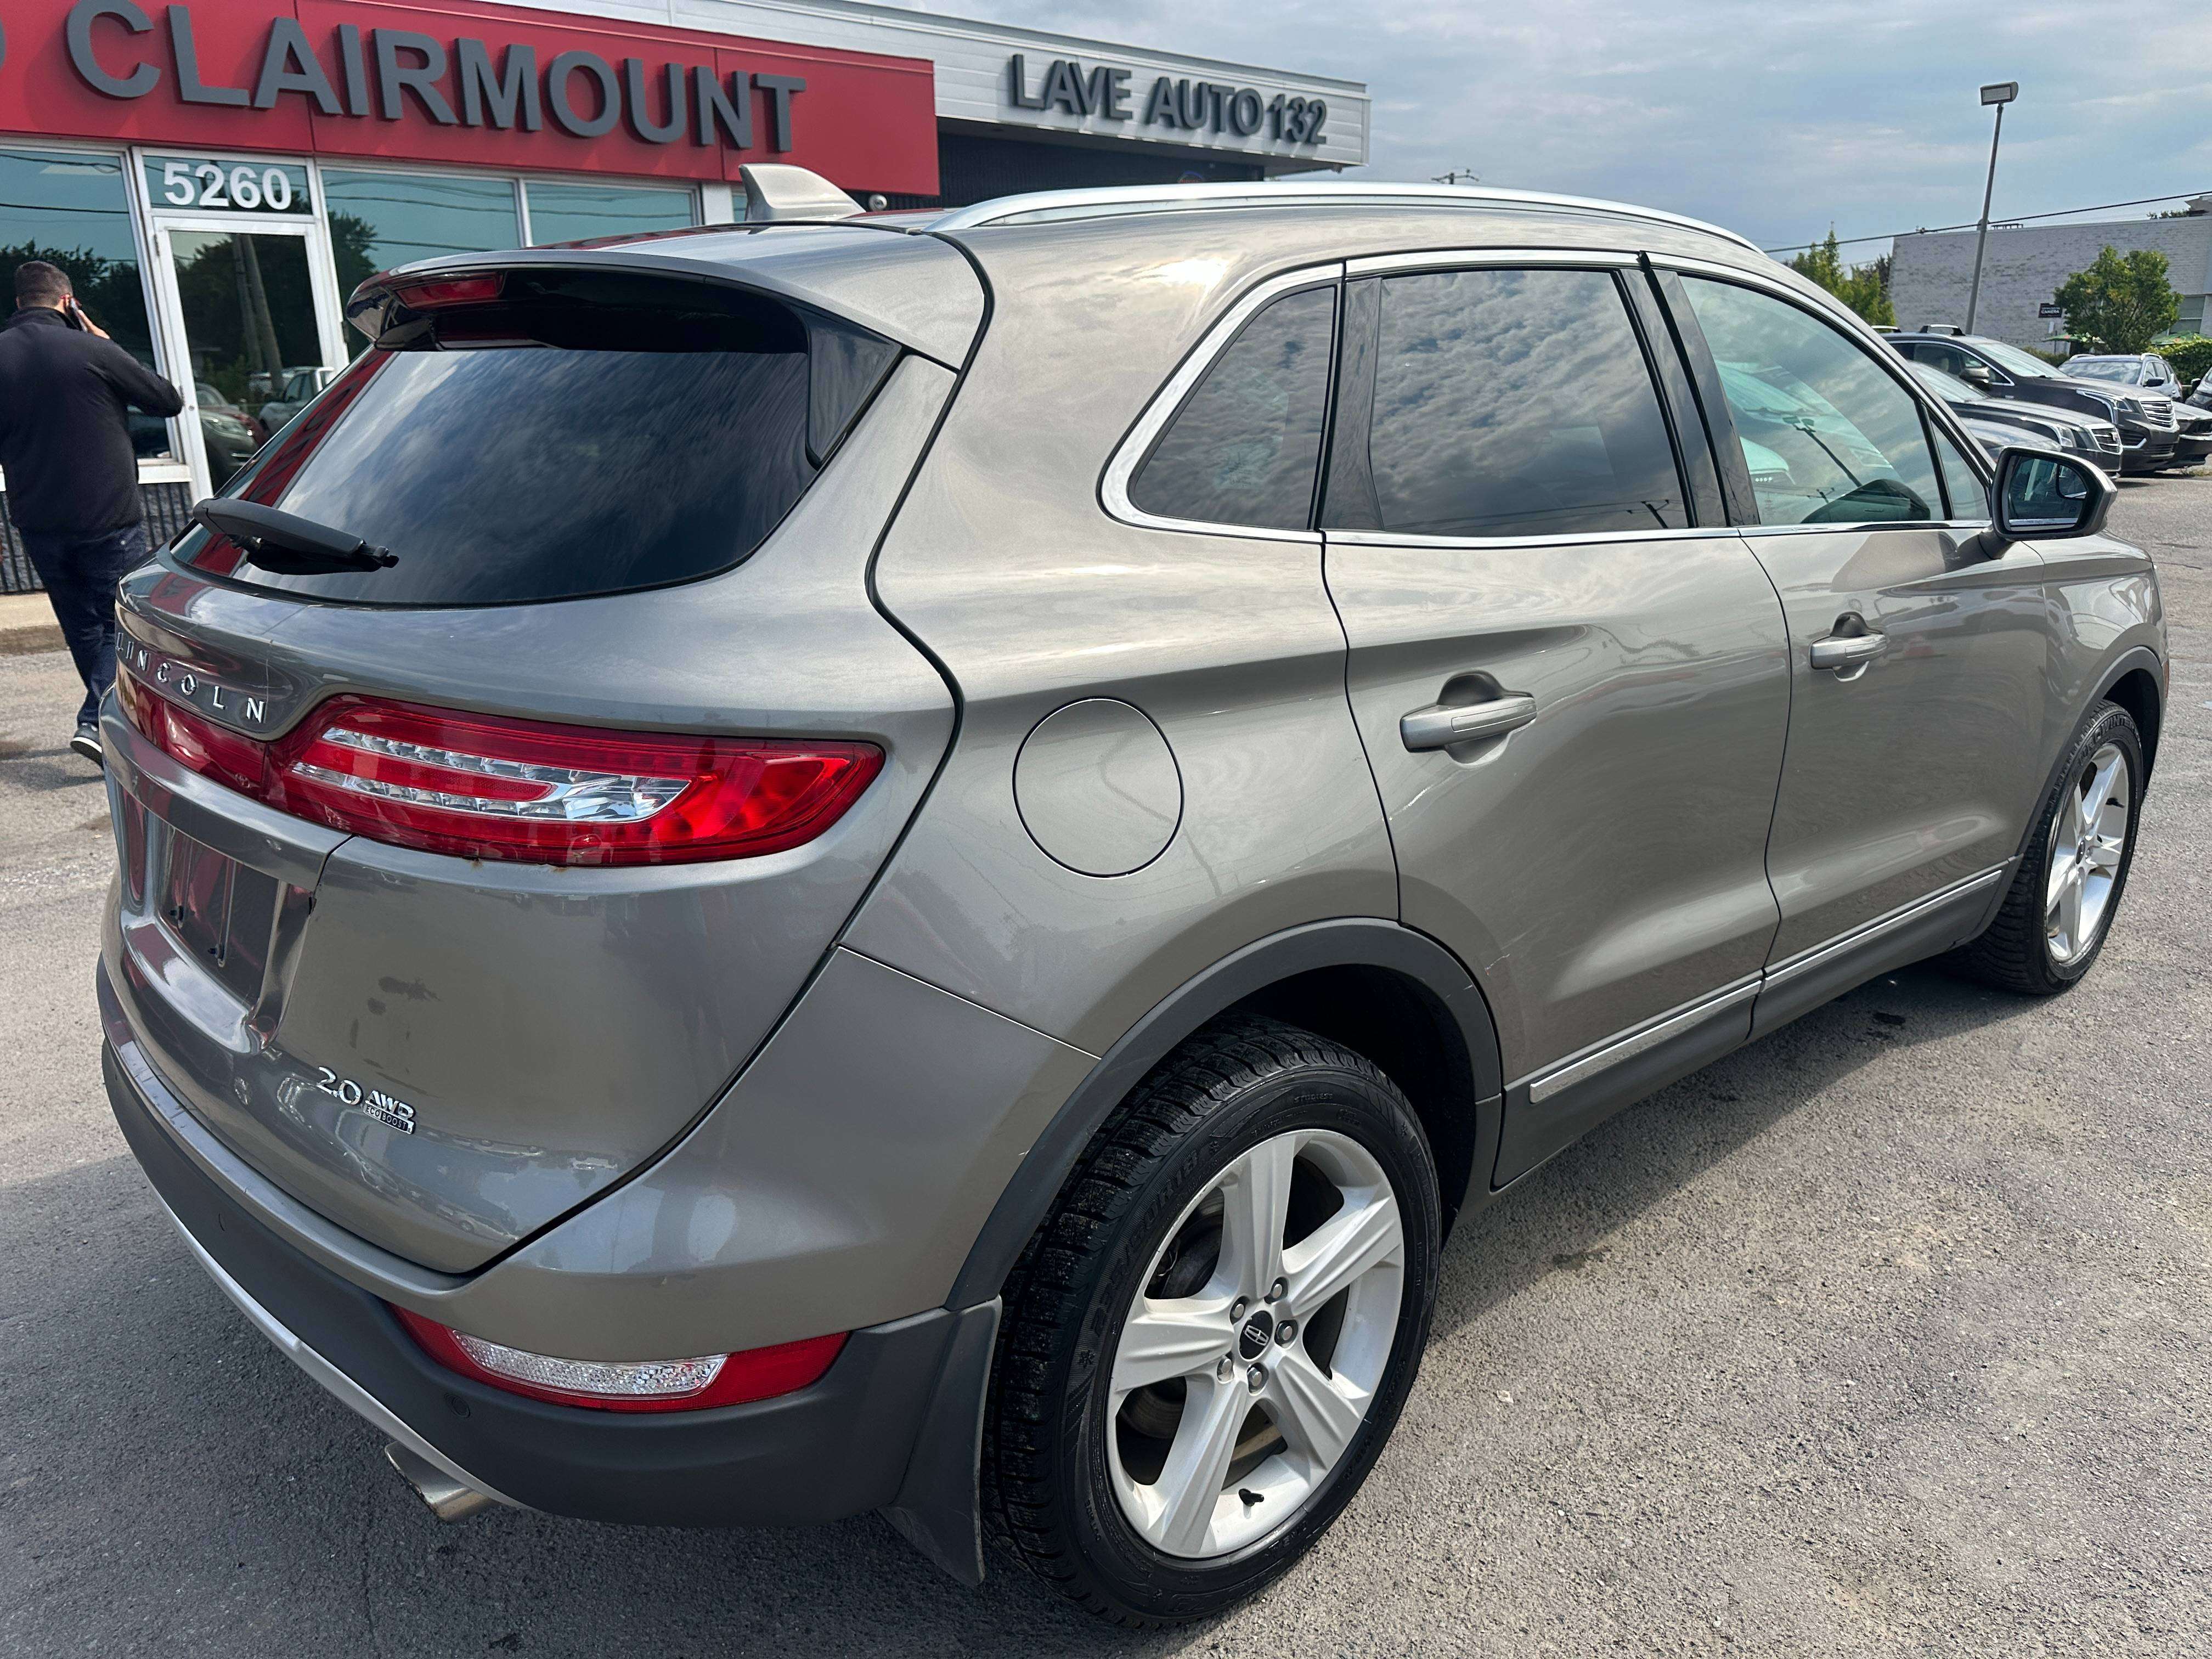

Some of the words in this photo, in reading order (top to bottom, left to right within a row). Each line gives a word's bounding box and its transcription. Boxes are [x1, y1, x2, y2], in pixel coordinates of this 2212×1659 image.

[66, 0, 806, 153] CLAIRMOUNT
[1012, 54, 1133, 120] LAVE
[1147, 76, 1264, 136] AUTO
[1266, 94, 1328, 145] 132
[163, 162, 292, 211] 5260
[115, 632, 266, 724] LINCOLN
[317, 1066, 363, 1105] 2.0
[366, 1090, 415, 1120] AWD
